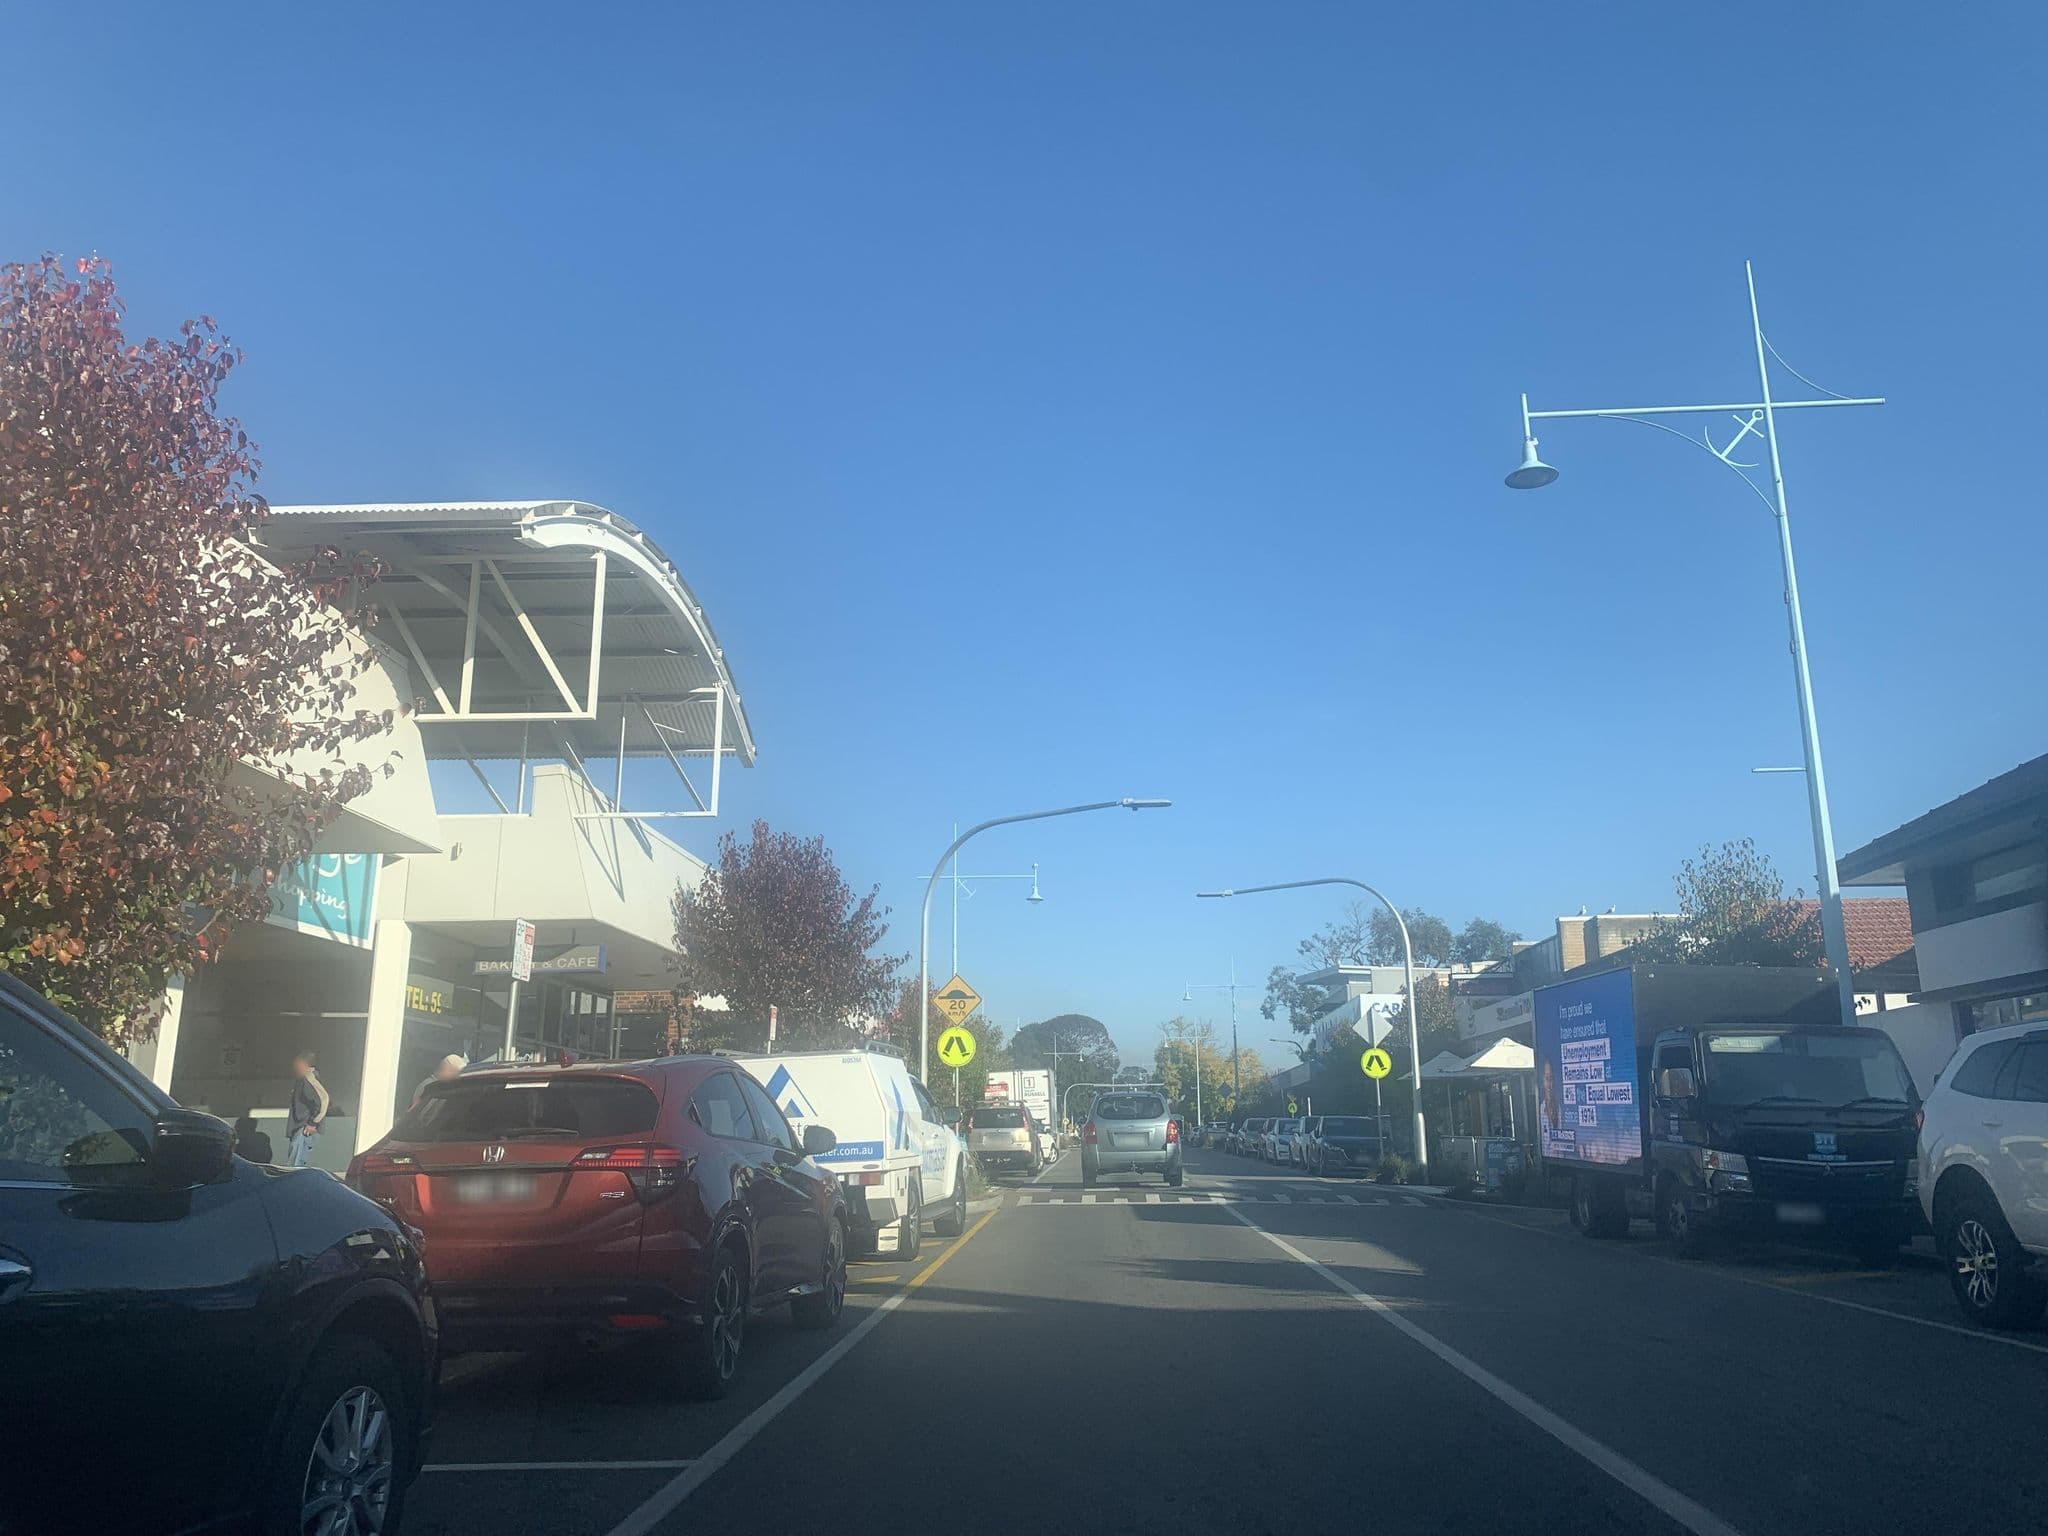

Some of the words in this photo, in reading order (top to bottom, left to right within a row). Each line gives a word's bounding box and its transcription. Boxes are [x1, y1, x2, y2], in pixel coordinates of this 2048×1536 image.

[557, 956, 598, 969] CAFE
[949, 999, 967, 1011] 20
[1562, 1040, 1608, 1062] Unemployment
[1563, 1064, 1589, 1081] Remains
[1589, 1064, 1603, 1080] Low
[1587, 1085, 1606, 1103] Equal
[1606, 1083, 1632, 1102] Lowest
